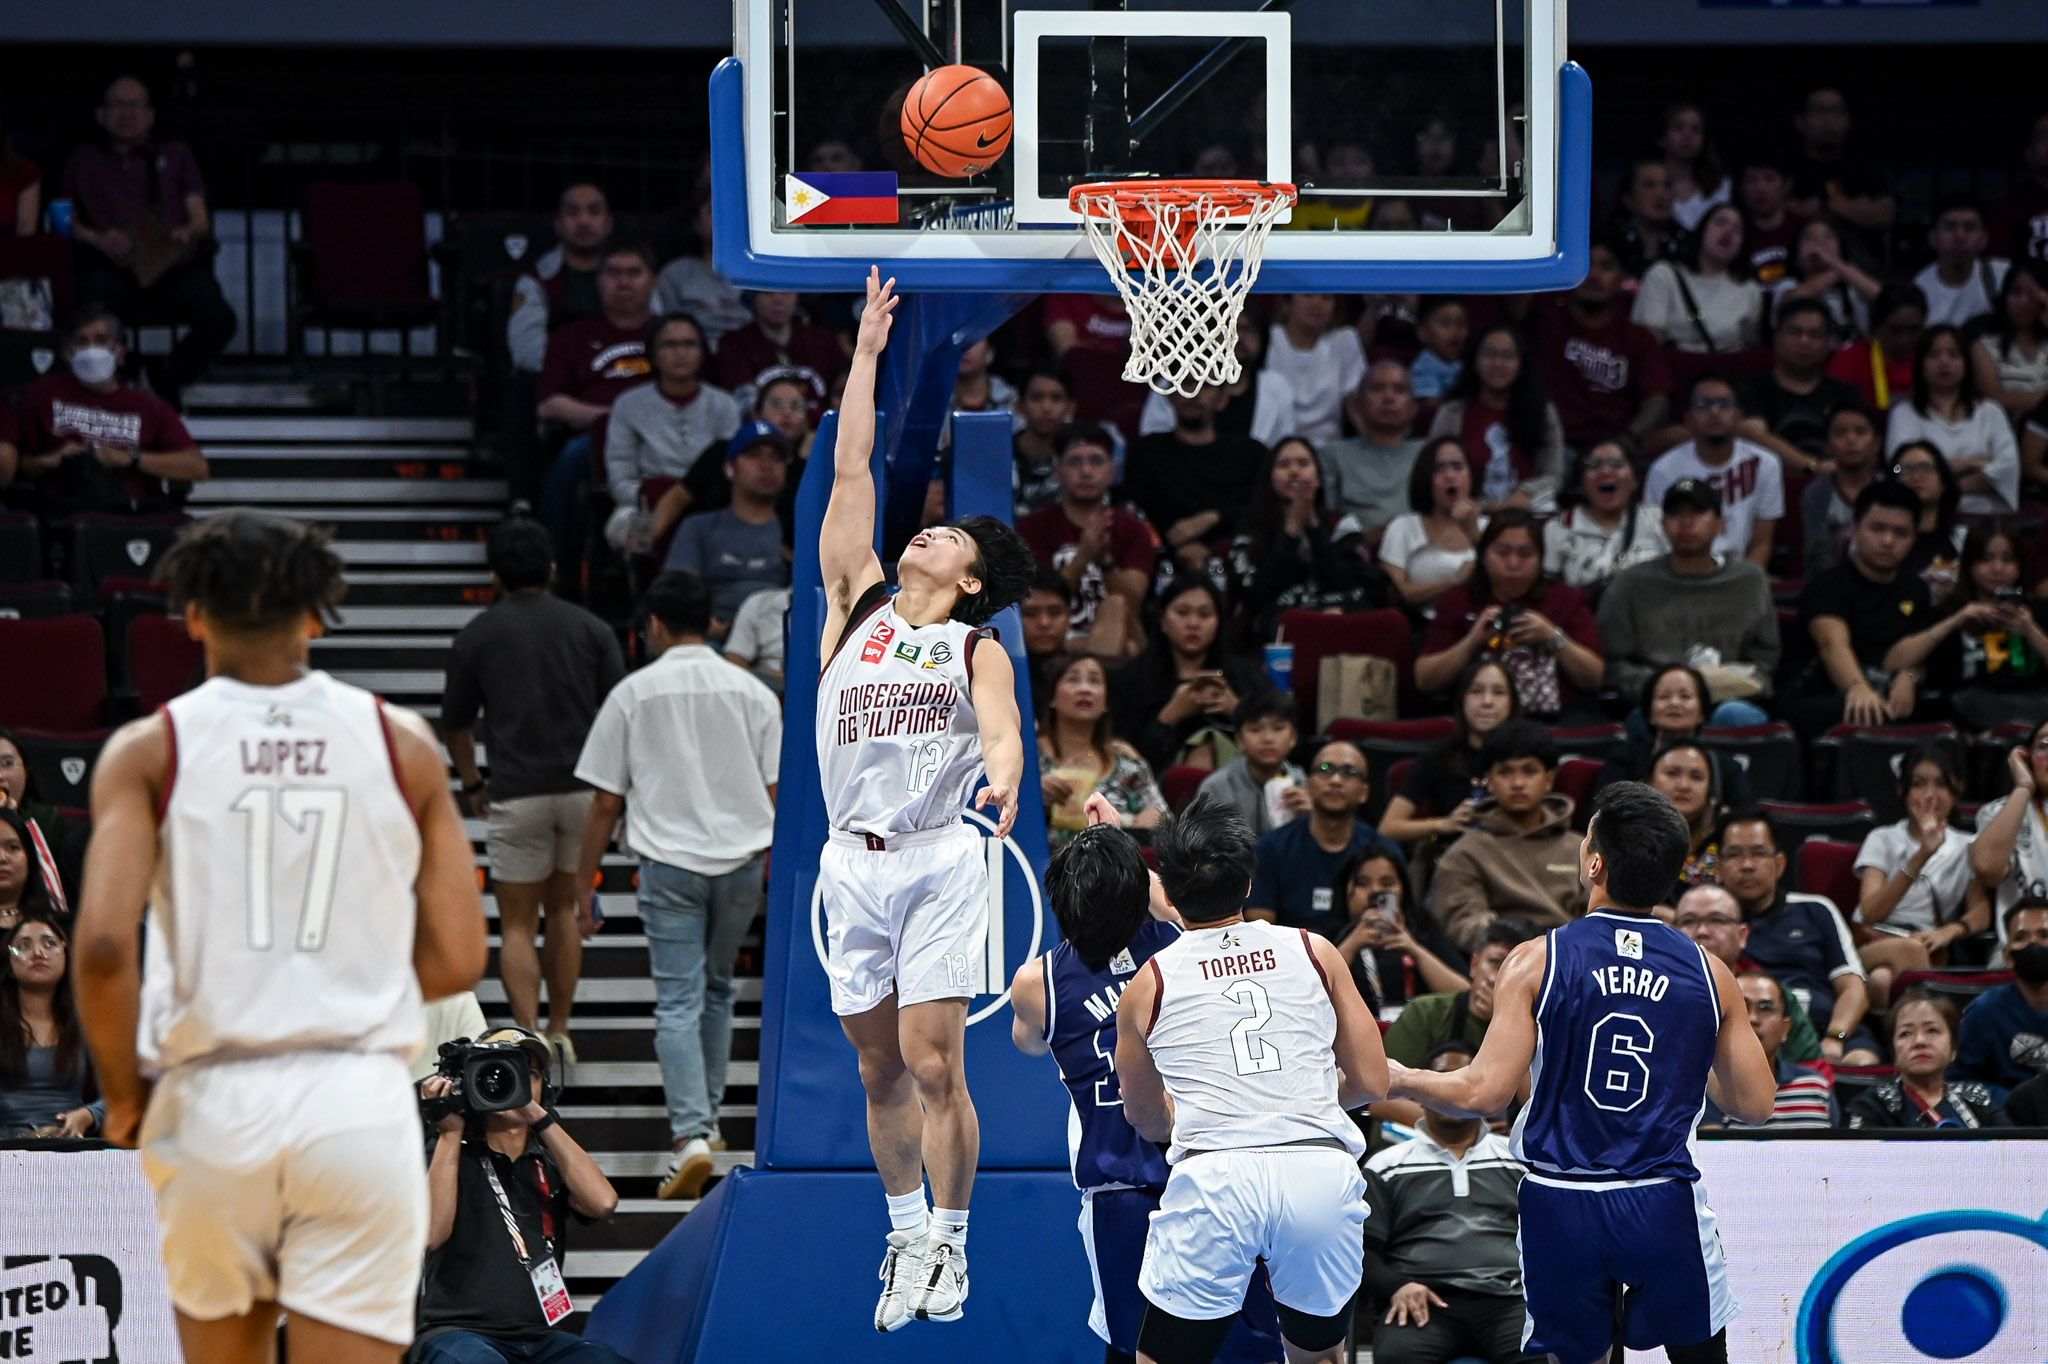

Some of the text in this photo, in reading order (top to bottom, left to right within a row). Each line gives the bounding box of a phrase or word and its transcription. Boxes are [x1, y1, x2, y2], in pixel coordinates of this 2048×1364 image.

[864, 647, 882, 658] BPI
[839, 682, 958, 716] UNIBERSIDAD
[837, 706, 952, 746] NG PILIPINAS
[240, 739, 327, 775] LOPEZ
[906, 739, 945, 793] 12
[229, 783, 350, 952] 17
[941, 952, 969, 988] 12
[1198, 948, 1277, 981] TORRES
[1592, 965, 1670, 1002] YERRO
[1221, 979, 1281, 1076] 2
[1584, 1012, 1654, 1112] 6
